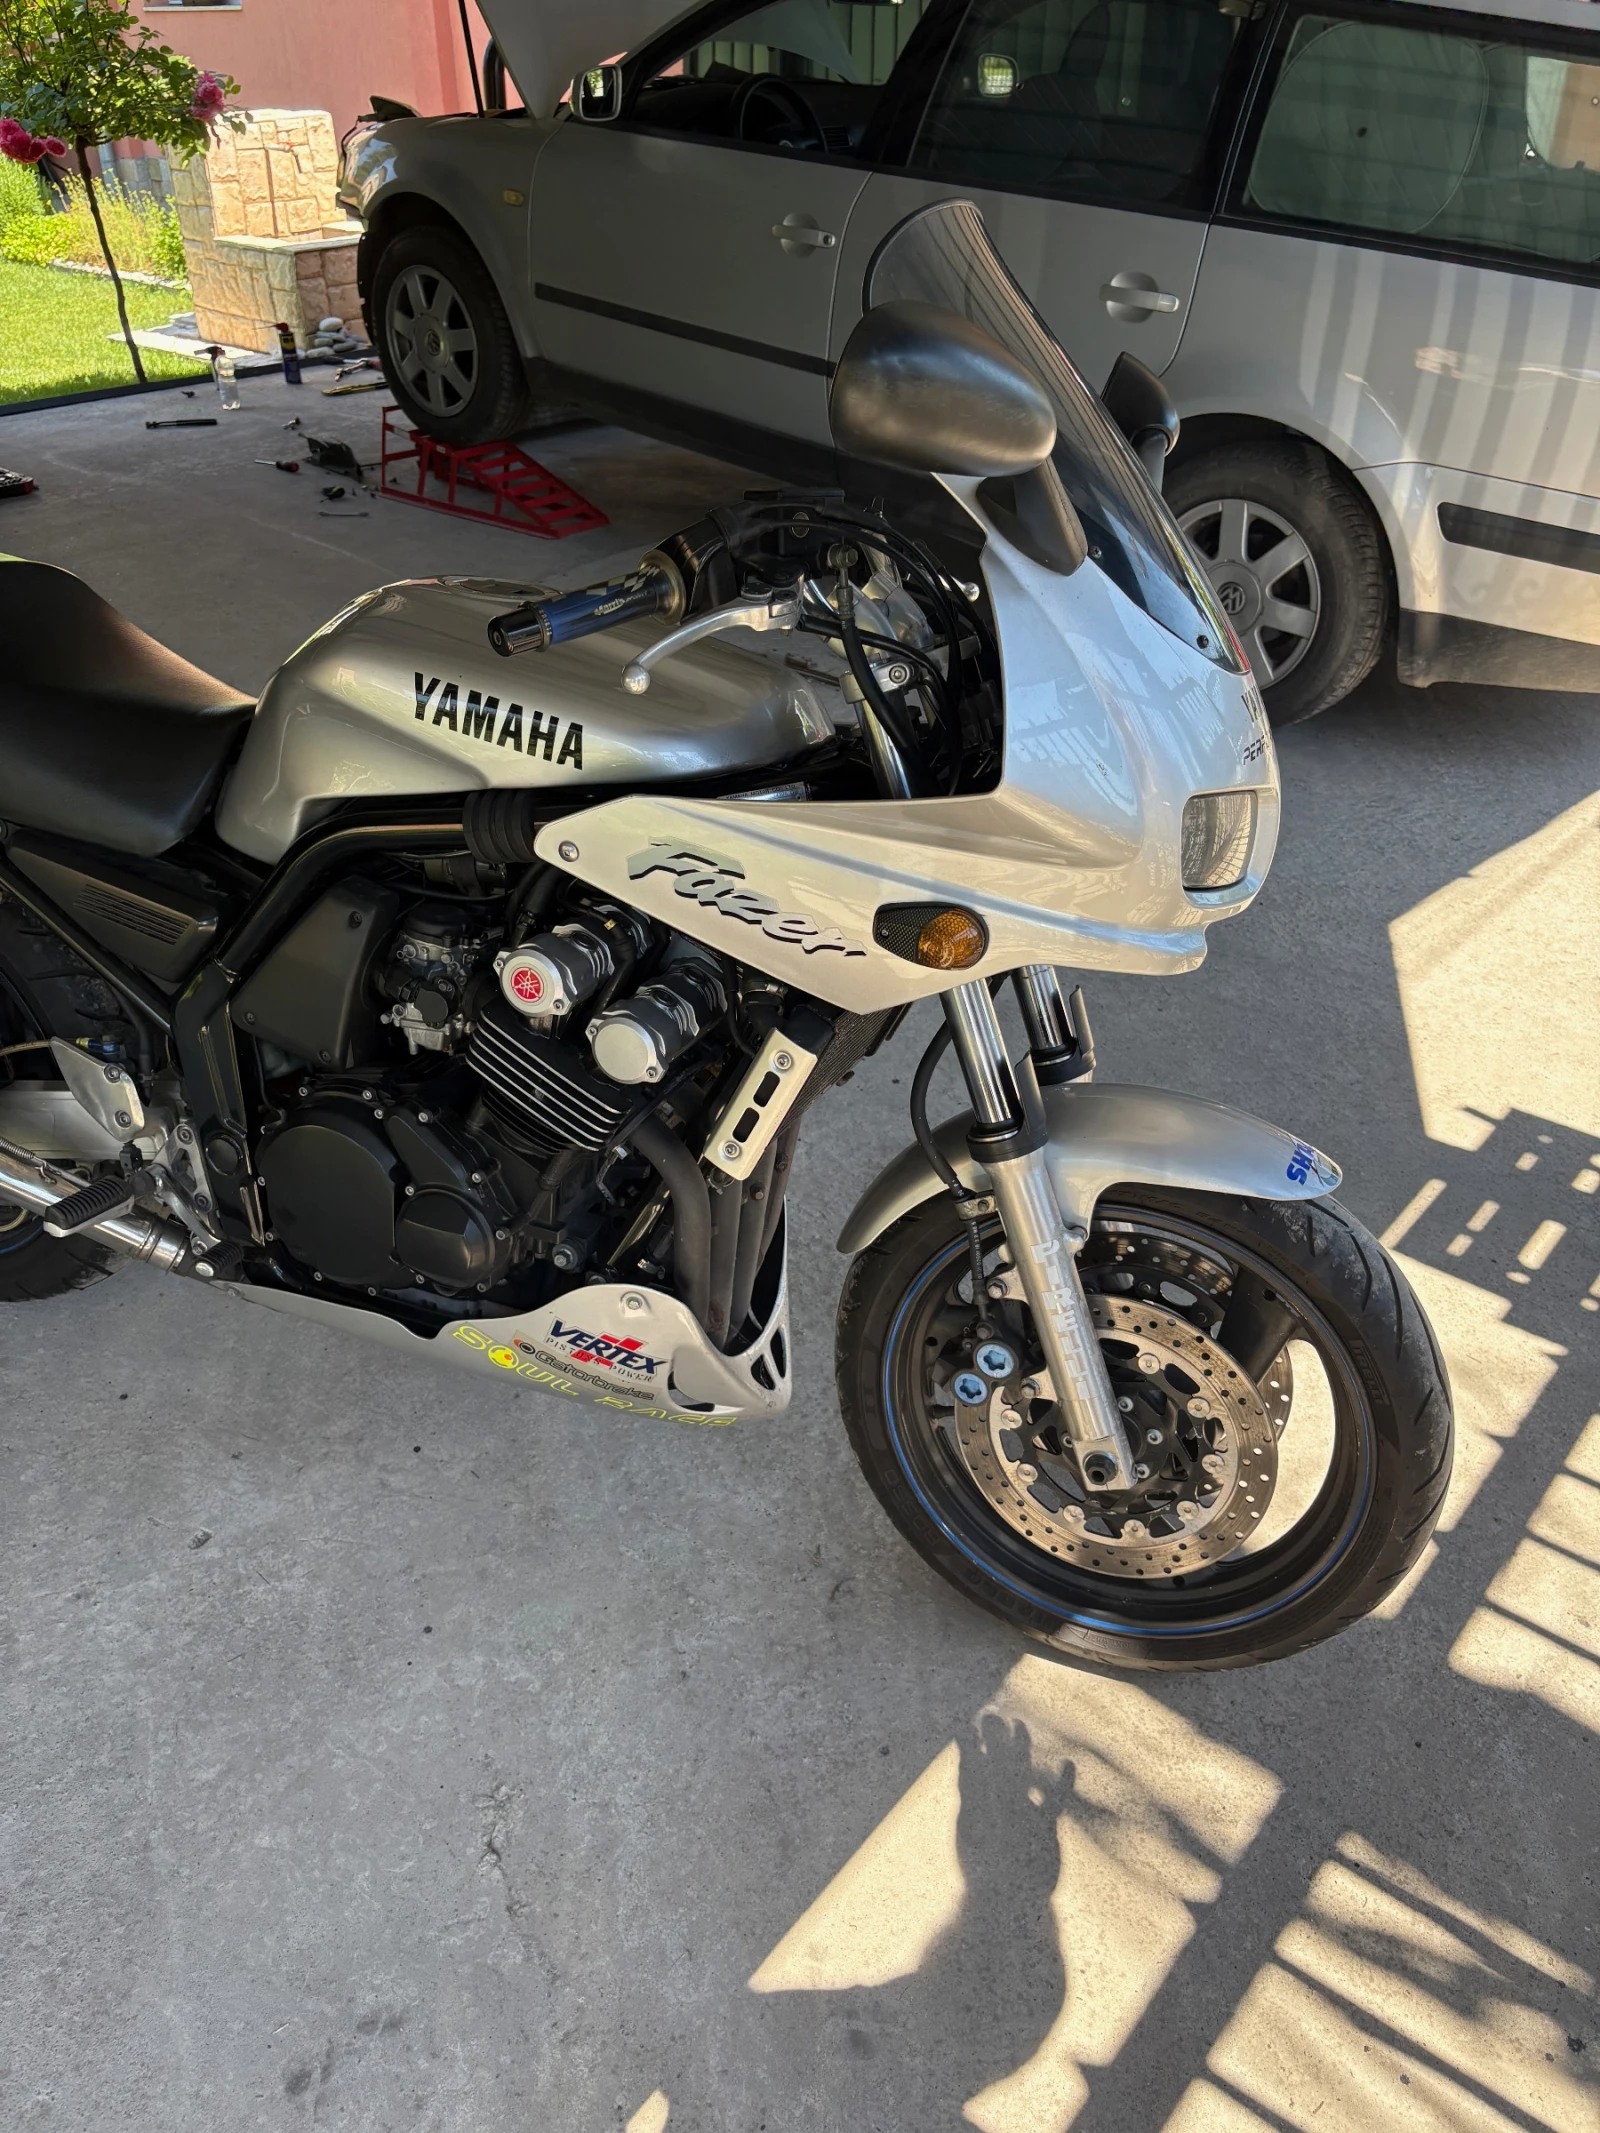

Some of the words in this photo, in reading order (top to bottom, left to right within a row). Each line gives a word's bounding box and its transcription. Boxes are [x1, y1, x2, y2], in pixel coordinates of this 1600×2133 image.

[414, 671, 584, 770] YAMAHA
[626, 836, 868, 957] Fazer
[545, 1337, 601, 1366] PISTONS
[551, 1320, 668, 1374] VERTEX
[1030, 1239, 1091, 1399] PIRELLI
[452, 1326, 579, 1396] SOUL
[608, 1364, 653, 1383] POWER
